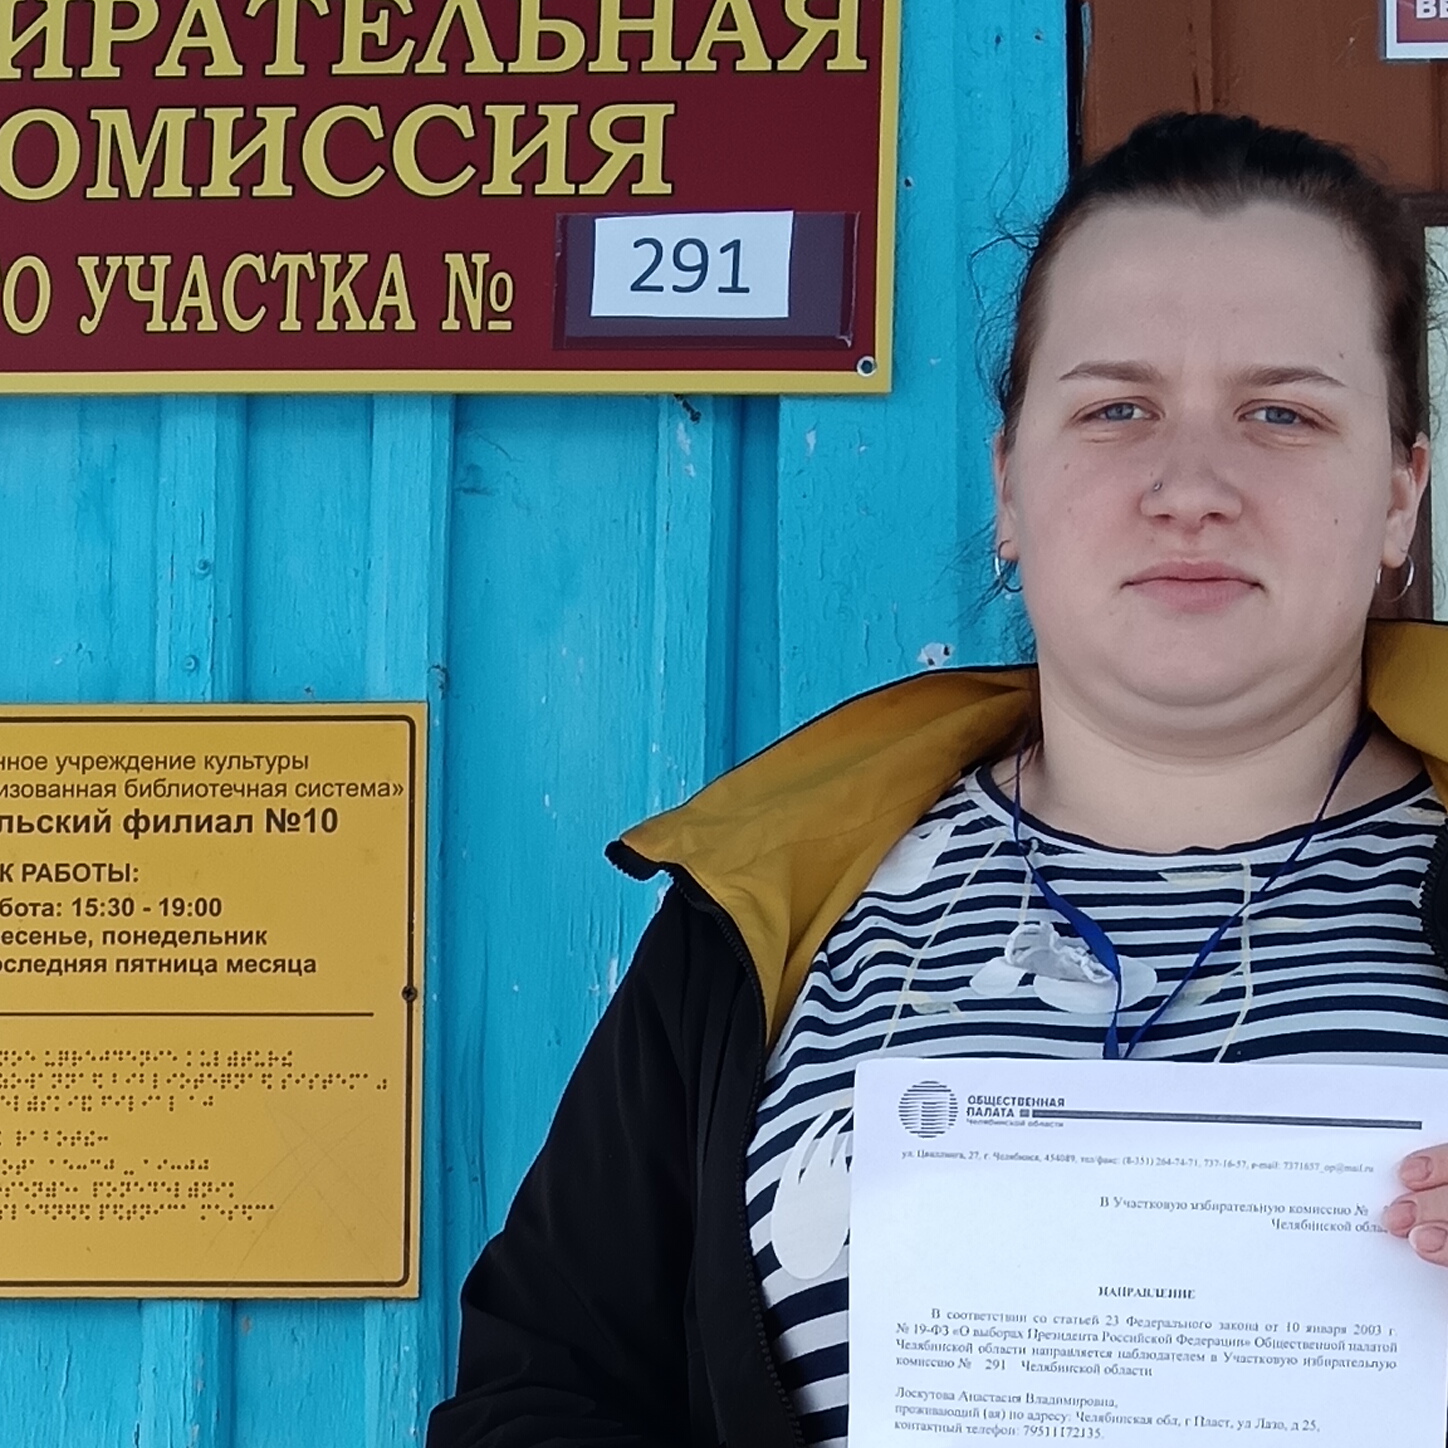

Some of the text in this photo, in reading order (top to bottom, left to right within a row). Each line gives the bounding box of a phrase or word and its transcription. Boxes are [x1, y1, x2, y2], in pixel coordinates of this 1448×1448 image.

[76, 250, 417, 333] УЧАСТКА
[443, 252, 516, 331] №
[627, 236, 755, 297] 291
[55, 755, 196, 775] учреждение
[204, 754, 308, 775] культуры
[124, 778, 287, 798] библиотечная
[294, 782, 404, 798] система»
[123, 808, 253, 838] филиал
[265, 807, 338, 833] №10
[21, 862, 138, 882] РАБОТЫ:
[71, 897, 134, 917] 15:30
[158, 897, 222, 917] 19:00
[102, 930, 267, 948] понедельник
[115, 958, 217, 976] пятница
[226, 958, 316, 977] месяца
[967, 1095, 1065, 1107] ОБЩЕСТВЕННАЯ
[966, 1107, 1015, 1118] ПАЛАТА
[1105, 1314, 1119, 1326] 23
[1286, 1321, 1300, 1333] 10
[1353, 1324, 1382, 1336] 2003
[985, 1358, 1005, 1370] 291
